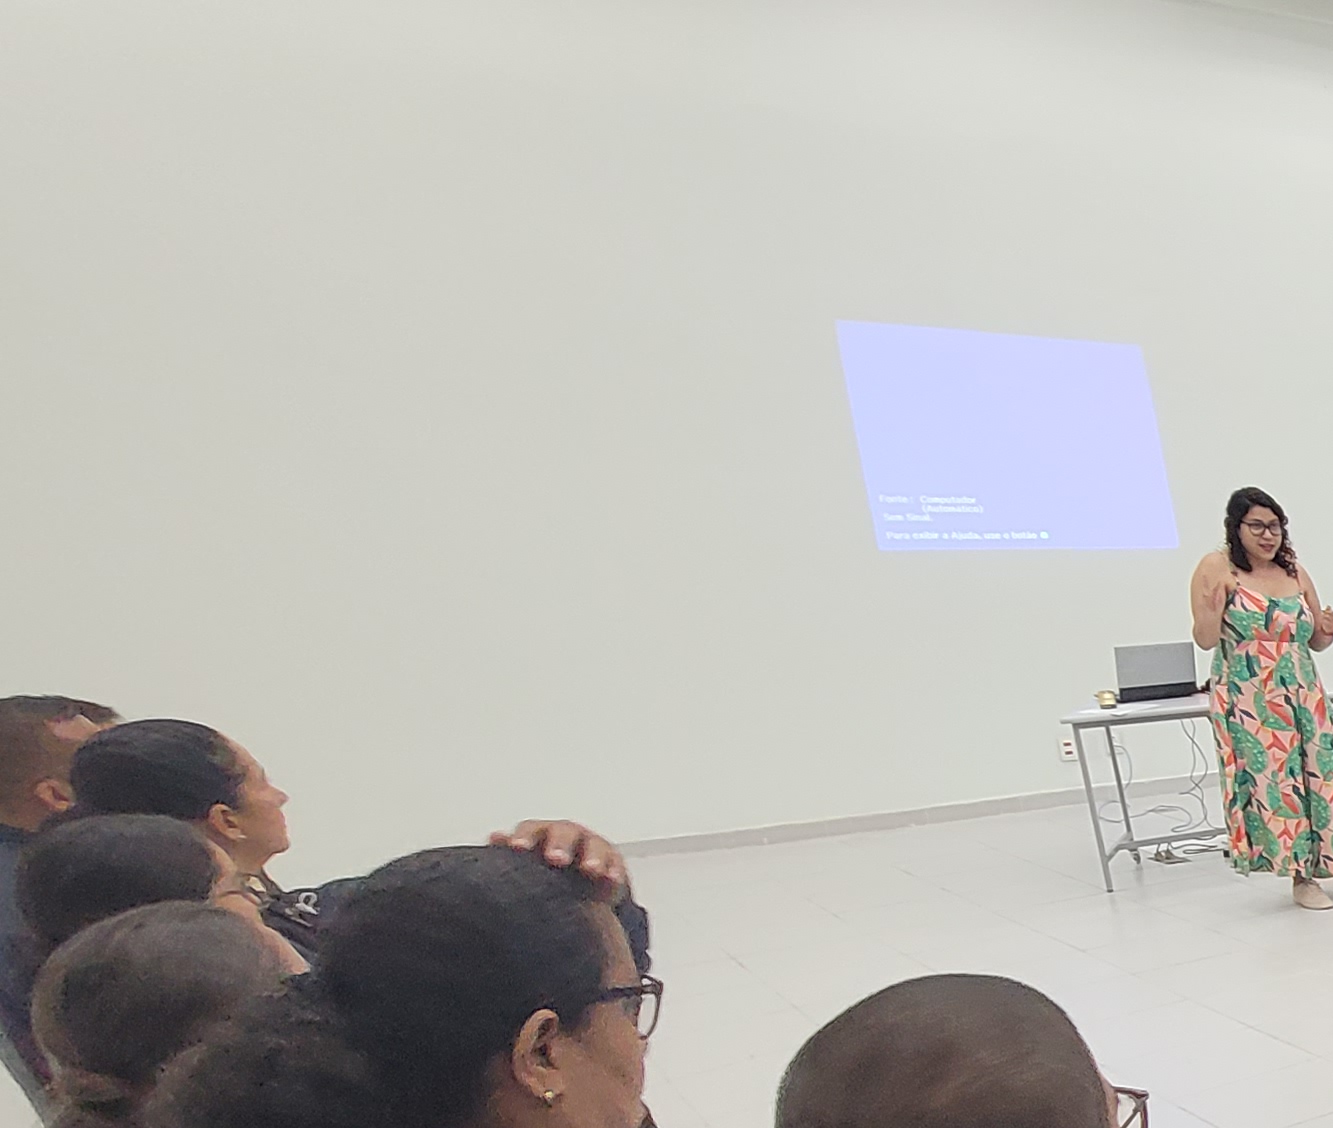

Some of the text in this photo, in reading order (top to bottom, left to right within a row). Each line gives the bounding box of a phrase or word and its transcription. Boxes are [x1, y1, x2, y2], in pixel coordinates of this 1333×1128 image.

[919, 494, 977, 505] Computador
[885, 530, 911, 540] Para
[911, 530, 939, 540] exibir
[983, 532, 1001, 540] use
